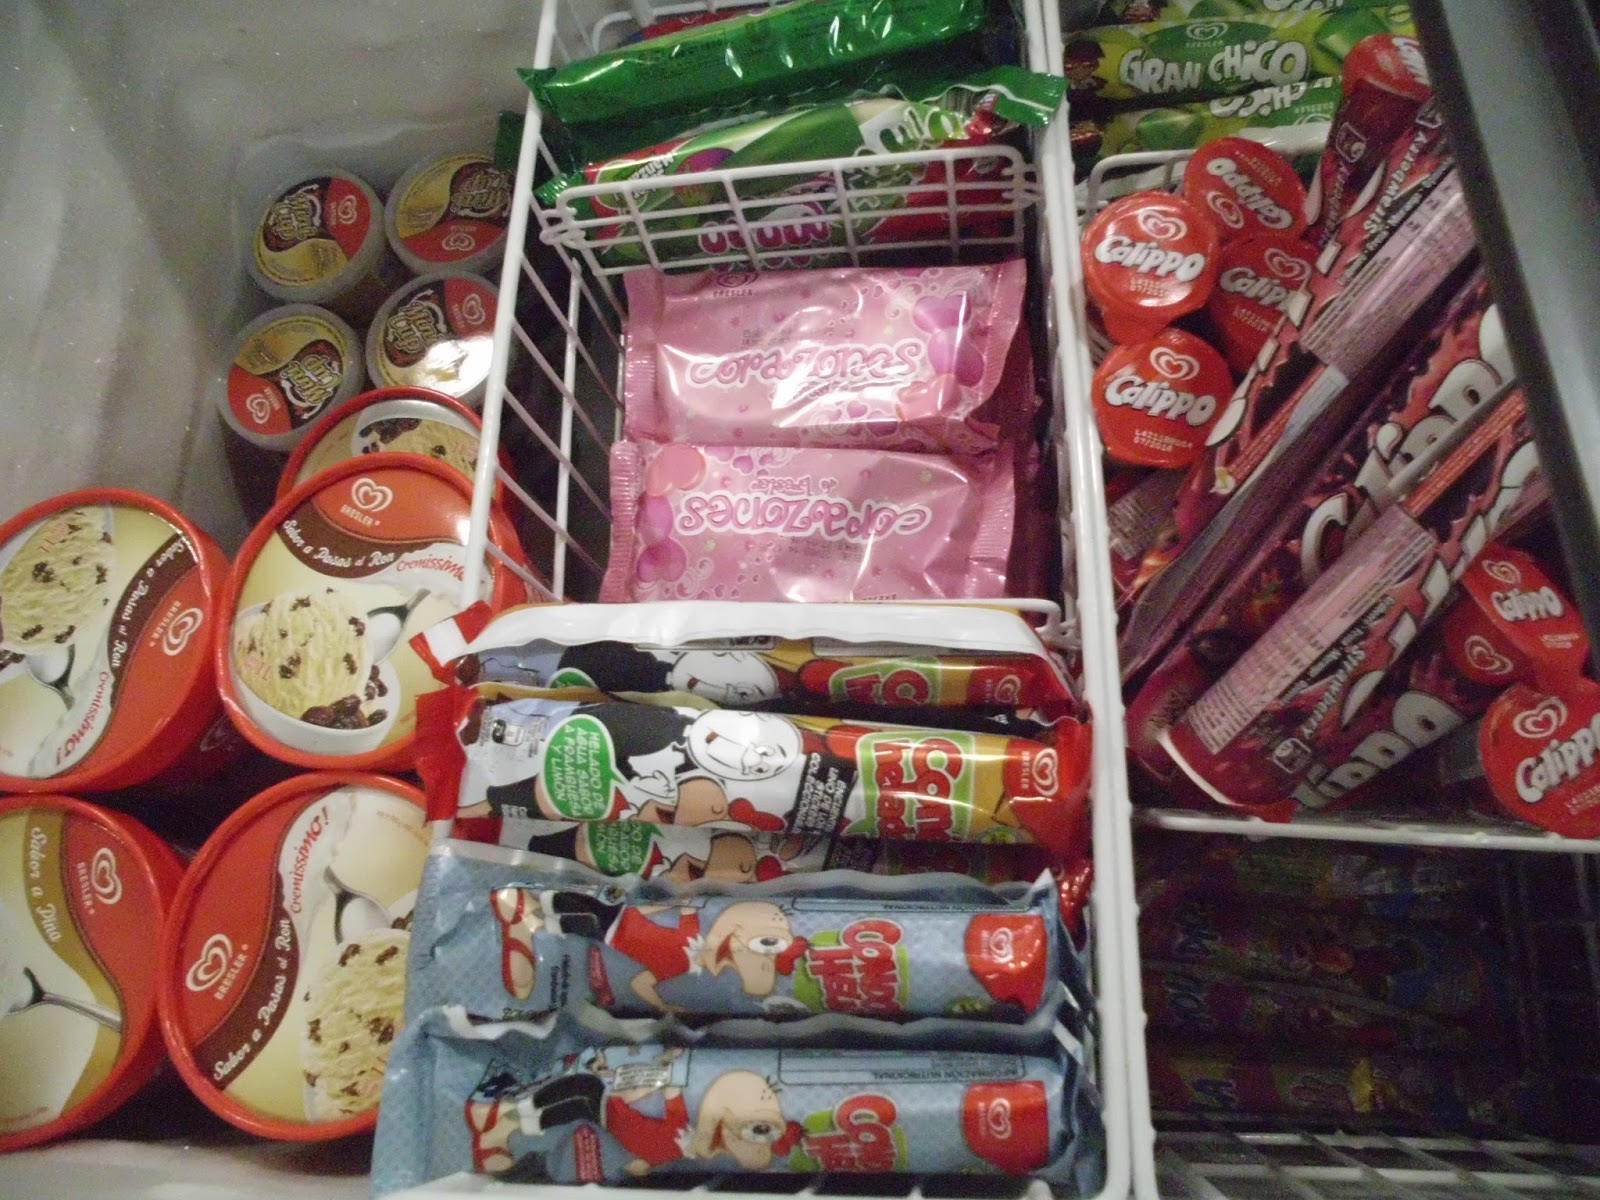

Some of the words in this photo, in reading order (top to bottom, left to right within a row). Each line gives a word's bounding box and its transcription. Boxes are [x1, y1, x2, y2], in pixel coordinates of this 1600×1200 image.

[1120, 49, 1200, 94] GRAN
[1206, 157, 1294, 230] Calippo
[1363, 130, 1427, 234] Strawberry
[1094, 234, 1206, 283] Calippo
[387, 311, 419, 353] Cup
[407, 302, 445, 346] Mini
[281, 361, 331, 404] Mini
[304, 354, 343, 389] Cup
[686, 342, 927, 388] corazones
[1105, 374, 1217, 426] Calippo
[341, 506, 374, 527] BRESLER
[676, 491, 932, 542] corazones
[283, 519, 304, 549] Sabor
[302, 545, 314, 555] a
[313, 547, 352, 568] Pasas
[370, 551, 396, 567] Ron
[146, 566, 155, 578] a
[121, 579, 150, 622] Pasas
[153, 600, 182, 642] BRESLER
[110, 640, 129, 669] Ron
[1302, 644, 1366, 740] Strawberry
[55, 671, 108, 767] Cremissimo!
[565, 724, 576, 733] A
[551, 745, 562, 756] Y
[576, 727, 589, 765] AGUA
[587, 731, 602, 789] HELADO
[577, 769, 594, 816] SABOR
[825, 767, 839, 794] UNO
[1021, 750, 1030, 790] BRESLER
[592, 791, 607, 811] DE
[31, 826, 48, 879] Sabor
[290, 805, 330, 914] Cremissimo!
[32, 887, 43, 897] a
[76, 861, 93, 909] BRESLER
[214, 953, 246, 1001] BRESLER
[213, 1042, 251, 1081] Sabor
[252, 1029, 262, 1042] a
[257, 972, 288, 1028] Pasas
[276, 919, 290, 952] Ron
